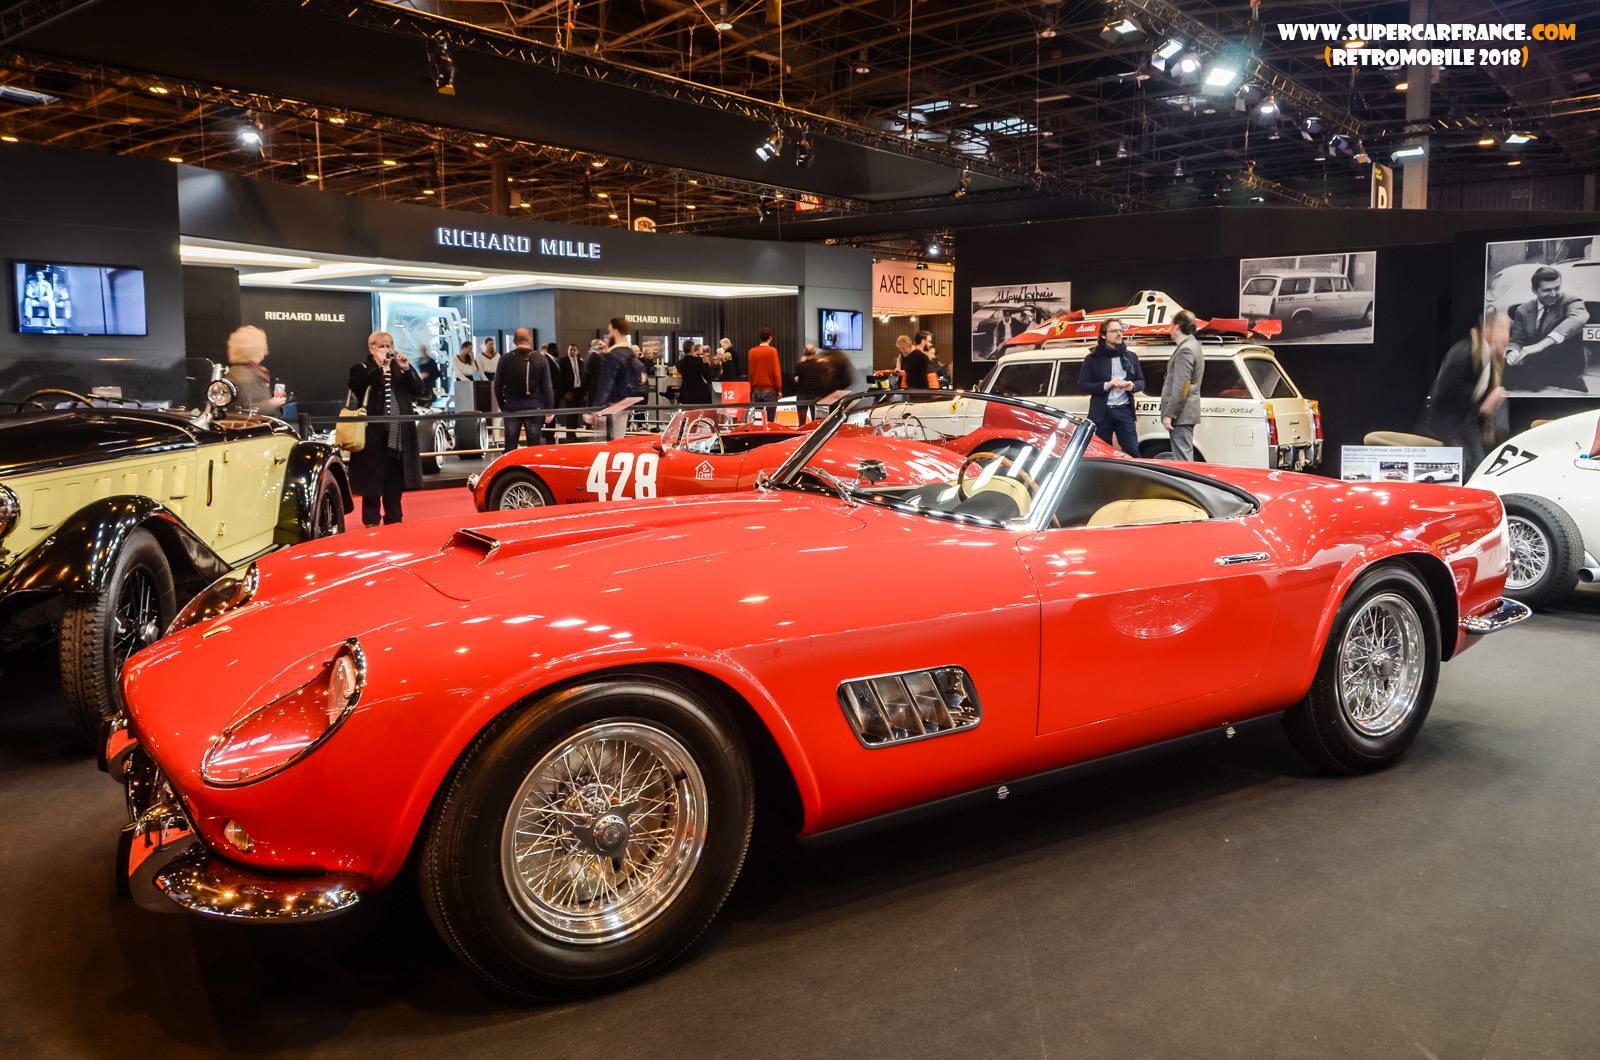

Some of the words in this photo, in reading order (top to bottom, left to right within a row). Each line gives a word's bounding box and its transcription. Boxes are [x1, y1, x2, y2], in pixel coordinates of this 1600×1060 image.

[1378, 185, 1388, 209] D
[438, 227, 531, 253] RICHARD
[541, 238, 601, 259] MILLE
[880, 274, 909, 294] AXEL
[913, 276, 953, 297] SCHUET
[264, 311, 312, 321] RICHARD
[314, 313, 346, 323] MILLE
[624, 314, 658, 324] RICHARD
[659, 316, 682, 325] MILLE
[1146, 303, 1168, 325] 11
[723, 390, 734, 400] 12
[1483, 443, 1539, 477] 67
[586, 451, 660, 503] 428
